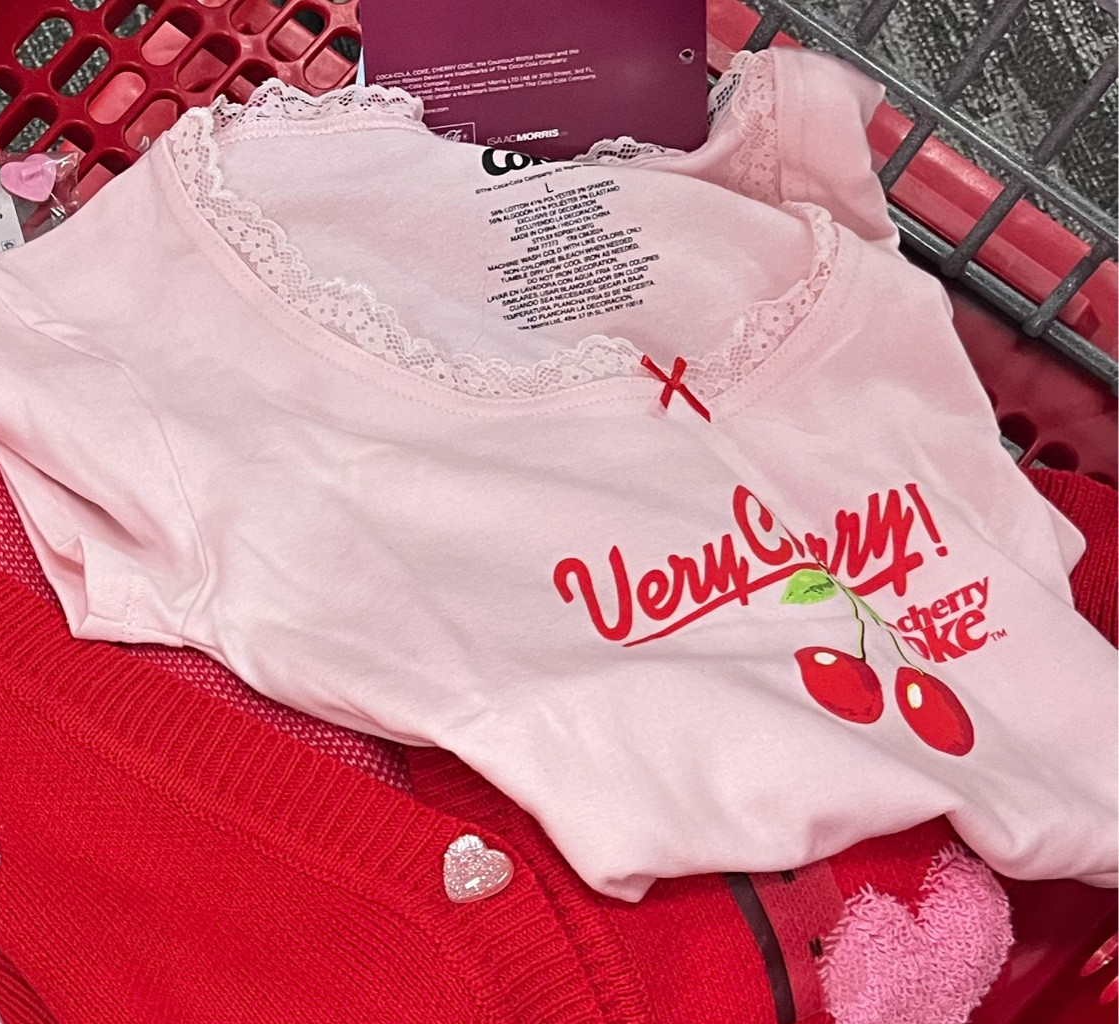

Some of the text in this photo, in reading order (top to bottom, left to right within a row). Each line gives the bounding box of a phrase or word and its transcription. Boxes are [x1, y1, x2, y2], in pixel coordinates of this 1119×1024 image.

[493, 179, 523, 190] Coca-Cola
[504, 203, 529, 213] COTTON
[543, 189, 576, 202] POLYESTER
[587, 180, 614, 191] SPANDEX
[545, 183, 554, 193] L
[510, 232, 529, 241] MADE
[537, 225, 557, 234] CHINA
[561, 218, 582, 227] HECHO
[592, 210, 610, 219] CHINA
[517, 212, 548, 225] EXCLUSIVE
[558, 199, 597, 214] DECORATION
[487, 260, 519, 271] MACHINE
[520, 254, 541, 263] WASH
[543, 247, 562, 257] COLD
[563, 242, 580, 251] WITH
[581, 237, 595, 246] LIKE
[557, 250, 584, 262] BLEACH
[585, 244, 605, 253] WHEN
[487, 292, 508, 303] LAVAR
[520, 281, 557, 294] LAVADORA
[574, 272, 594, 281] AGUA
[613, 263, 628, 271] CON
[629, 254, 659, 266] COLORES
[501, 272, 527, 282] TUMBLE
[530, 269, 544, 277] DRY
[546, 264, 561, 273] LOW
[563, 259, 582, 269] COOL
[584, 254, 600, 262] IRON
[540, 288, 559, 297] USAR
[625, 265, 648, 276] CLORO
[555, 270, 572, 278] IRON
[509, 299, 539, 312] CUANDO
[598, 280, 621, 291] SECAR
[628, 274, 644, 283] BAJA
[553, 298, 586, 308] PLANCHA
[538, 307, 575, 320] PLANCHAR
[553, 483, 948, 641] Very Crry!
[897, 576, 988, 632] cherry
